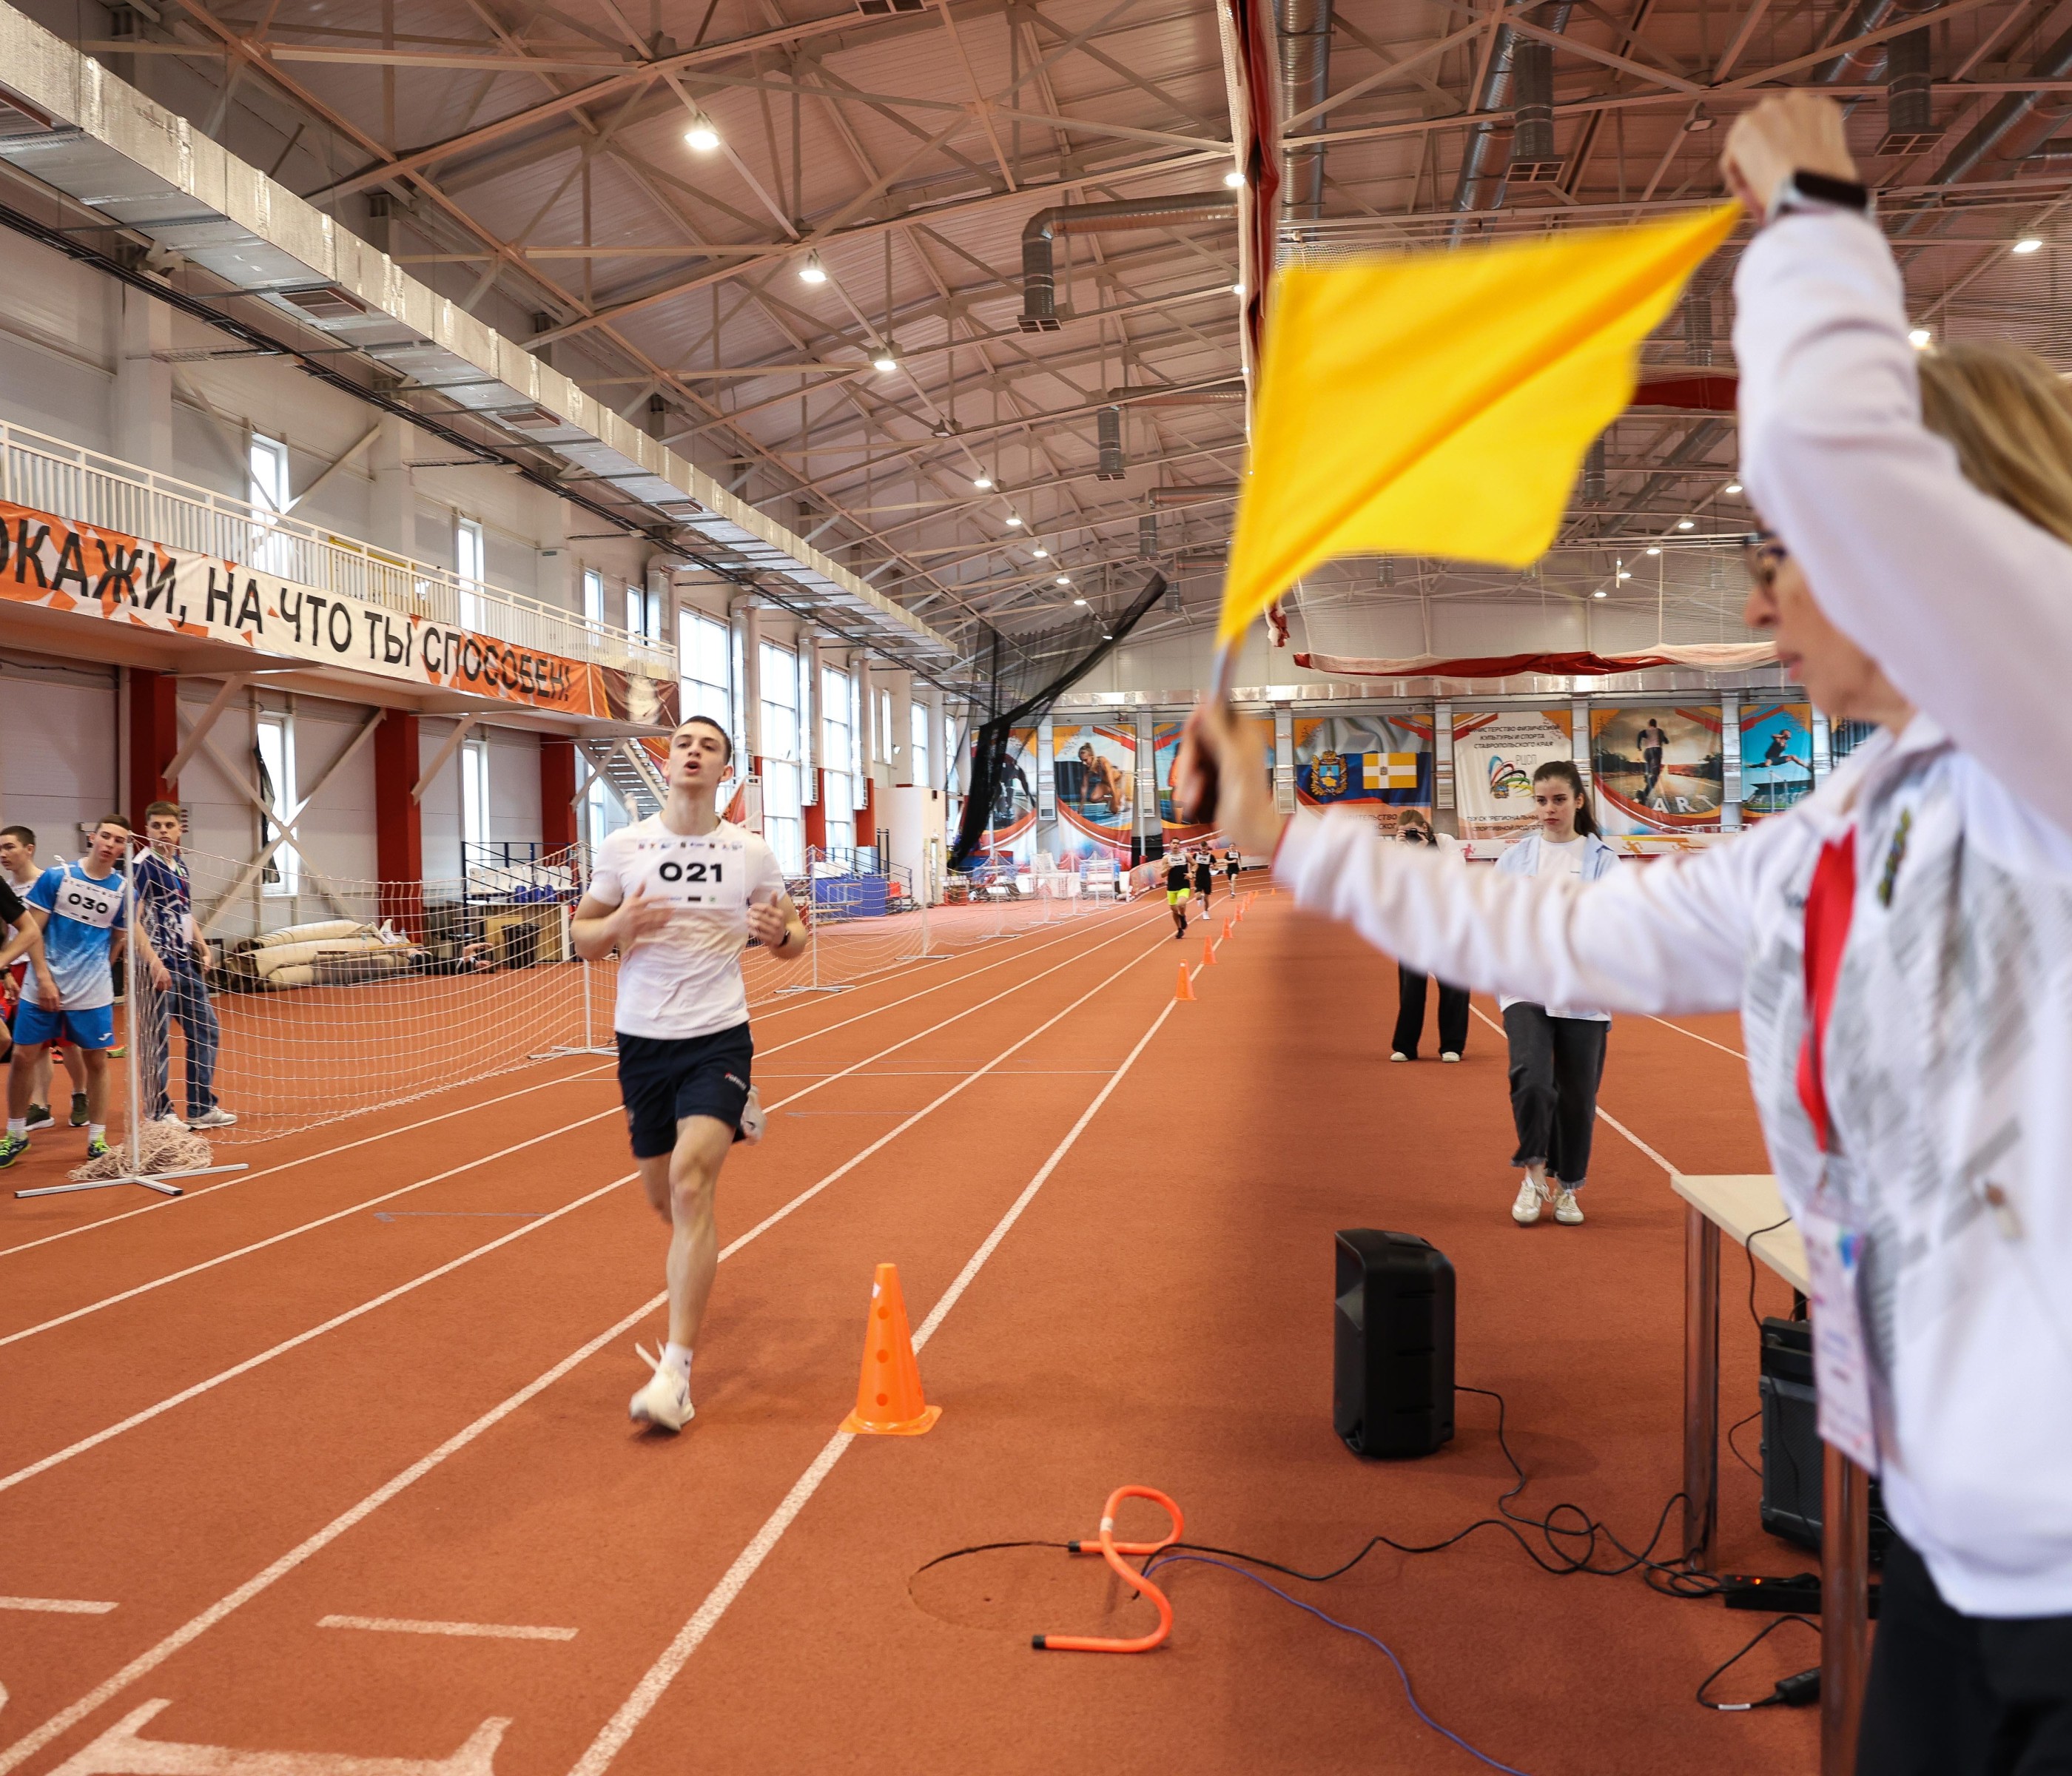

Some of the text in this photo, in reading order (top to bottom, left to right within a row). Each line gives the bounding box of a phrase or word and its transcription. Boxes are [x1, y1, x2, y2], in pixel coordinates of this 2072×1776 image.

[206, 567, 263, 634] НА
[280, 588, 352, 653] ЧТО
[364, 610, 412, 667] ТЫ
[423, 628, 570, 702] СПОСОБЕН!
[659, 861, 723, 883] 021
[67, 892, 110, 915] 030
